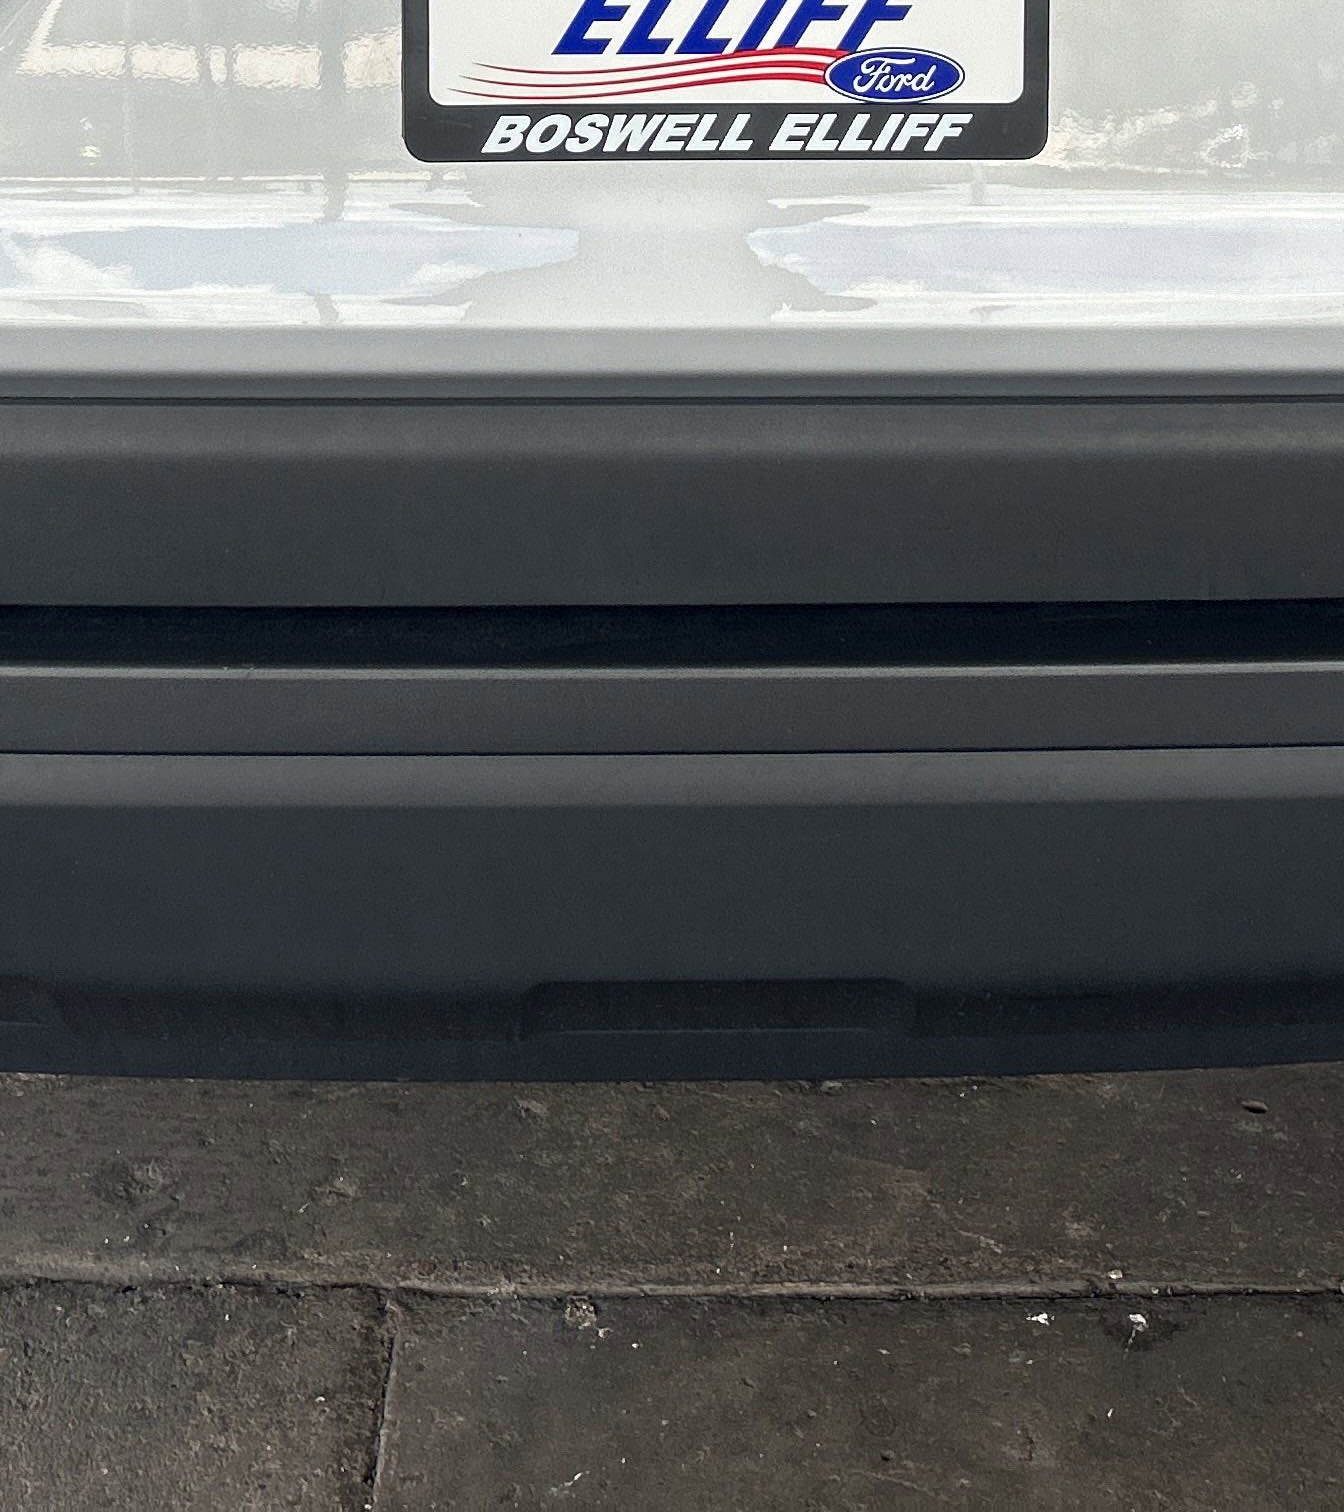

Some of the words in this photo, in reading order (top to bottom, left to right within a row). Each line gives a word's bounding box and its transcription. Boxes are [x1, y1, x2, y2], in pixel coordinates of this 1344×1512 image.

[853, 57, 936, 93] Ford
[481, 114, 760, 153] BOSWELL
[768, 114, 973, 153] ELLIFF
